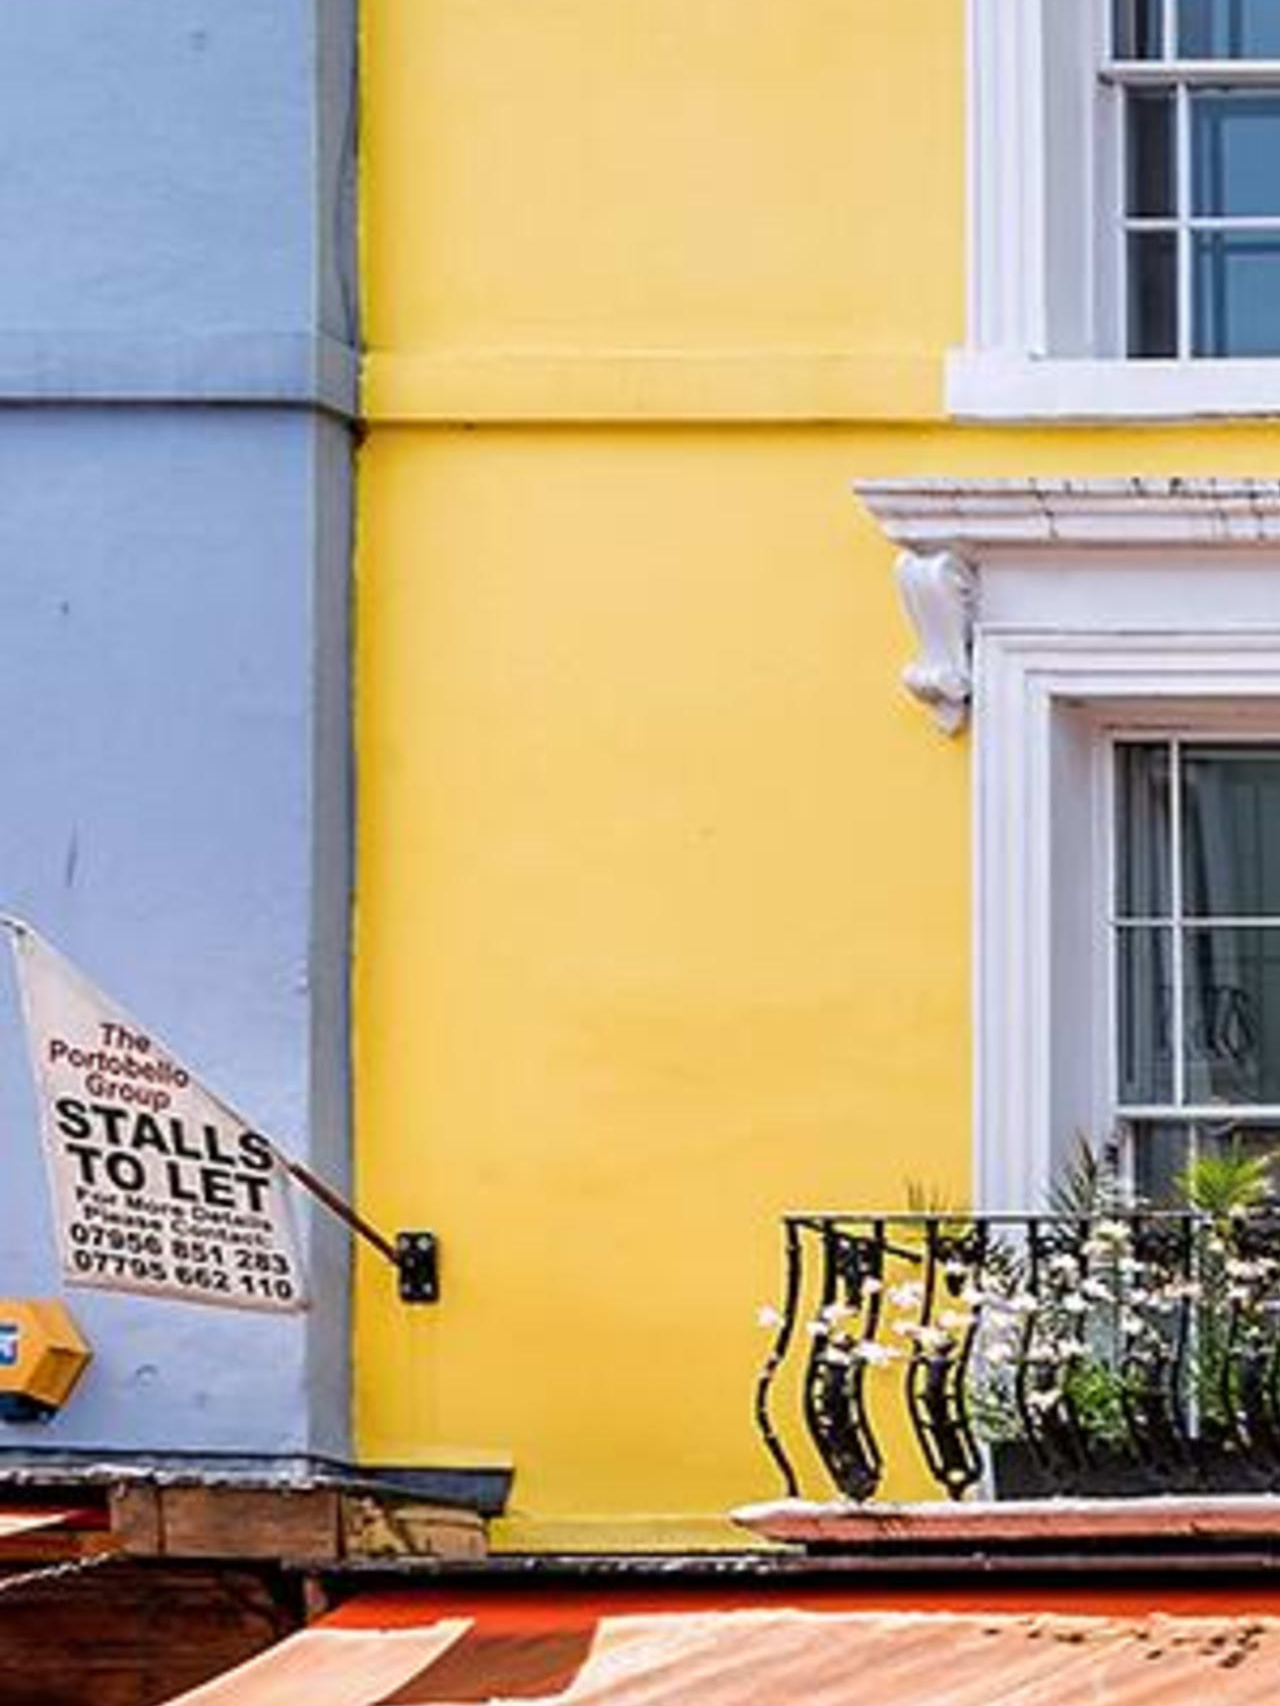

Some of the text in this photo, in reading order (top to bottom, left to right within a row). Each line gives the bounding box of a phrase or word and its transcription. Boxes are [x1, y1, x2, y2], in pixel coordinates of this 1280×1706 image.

[101, 1023, 151, 1054] The
[49, 1039, 189, 1089] Portobello
[85, 1073, 172, 1113] Group
[55, 1098, 274, 1172] STALLS
[65, 1143, 270, 1212] TO LET
[83, 1205, 163, 1231] Please
[124, 1192, 186, 1215] More
[191, 1205, 273, 1233] Details
[240, 1274, 293, 1301] 110
